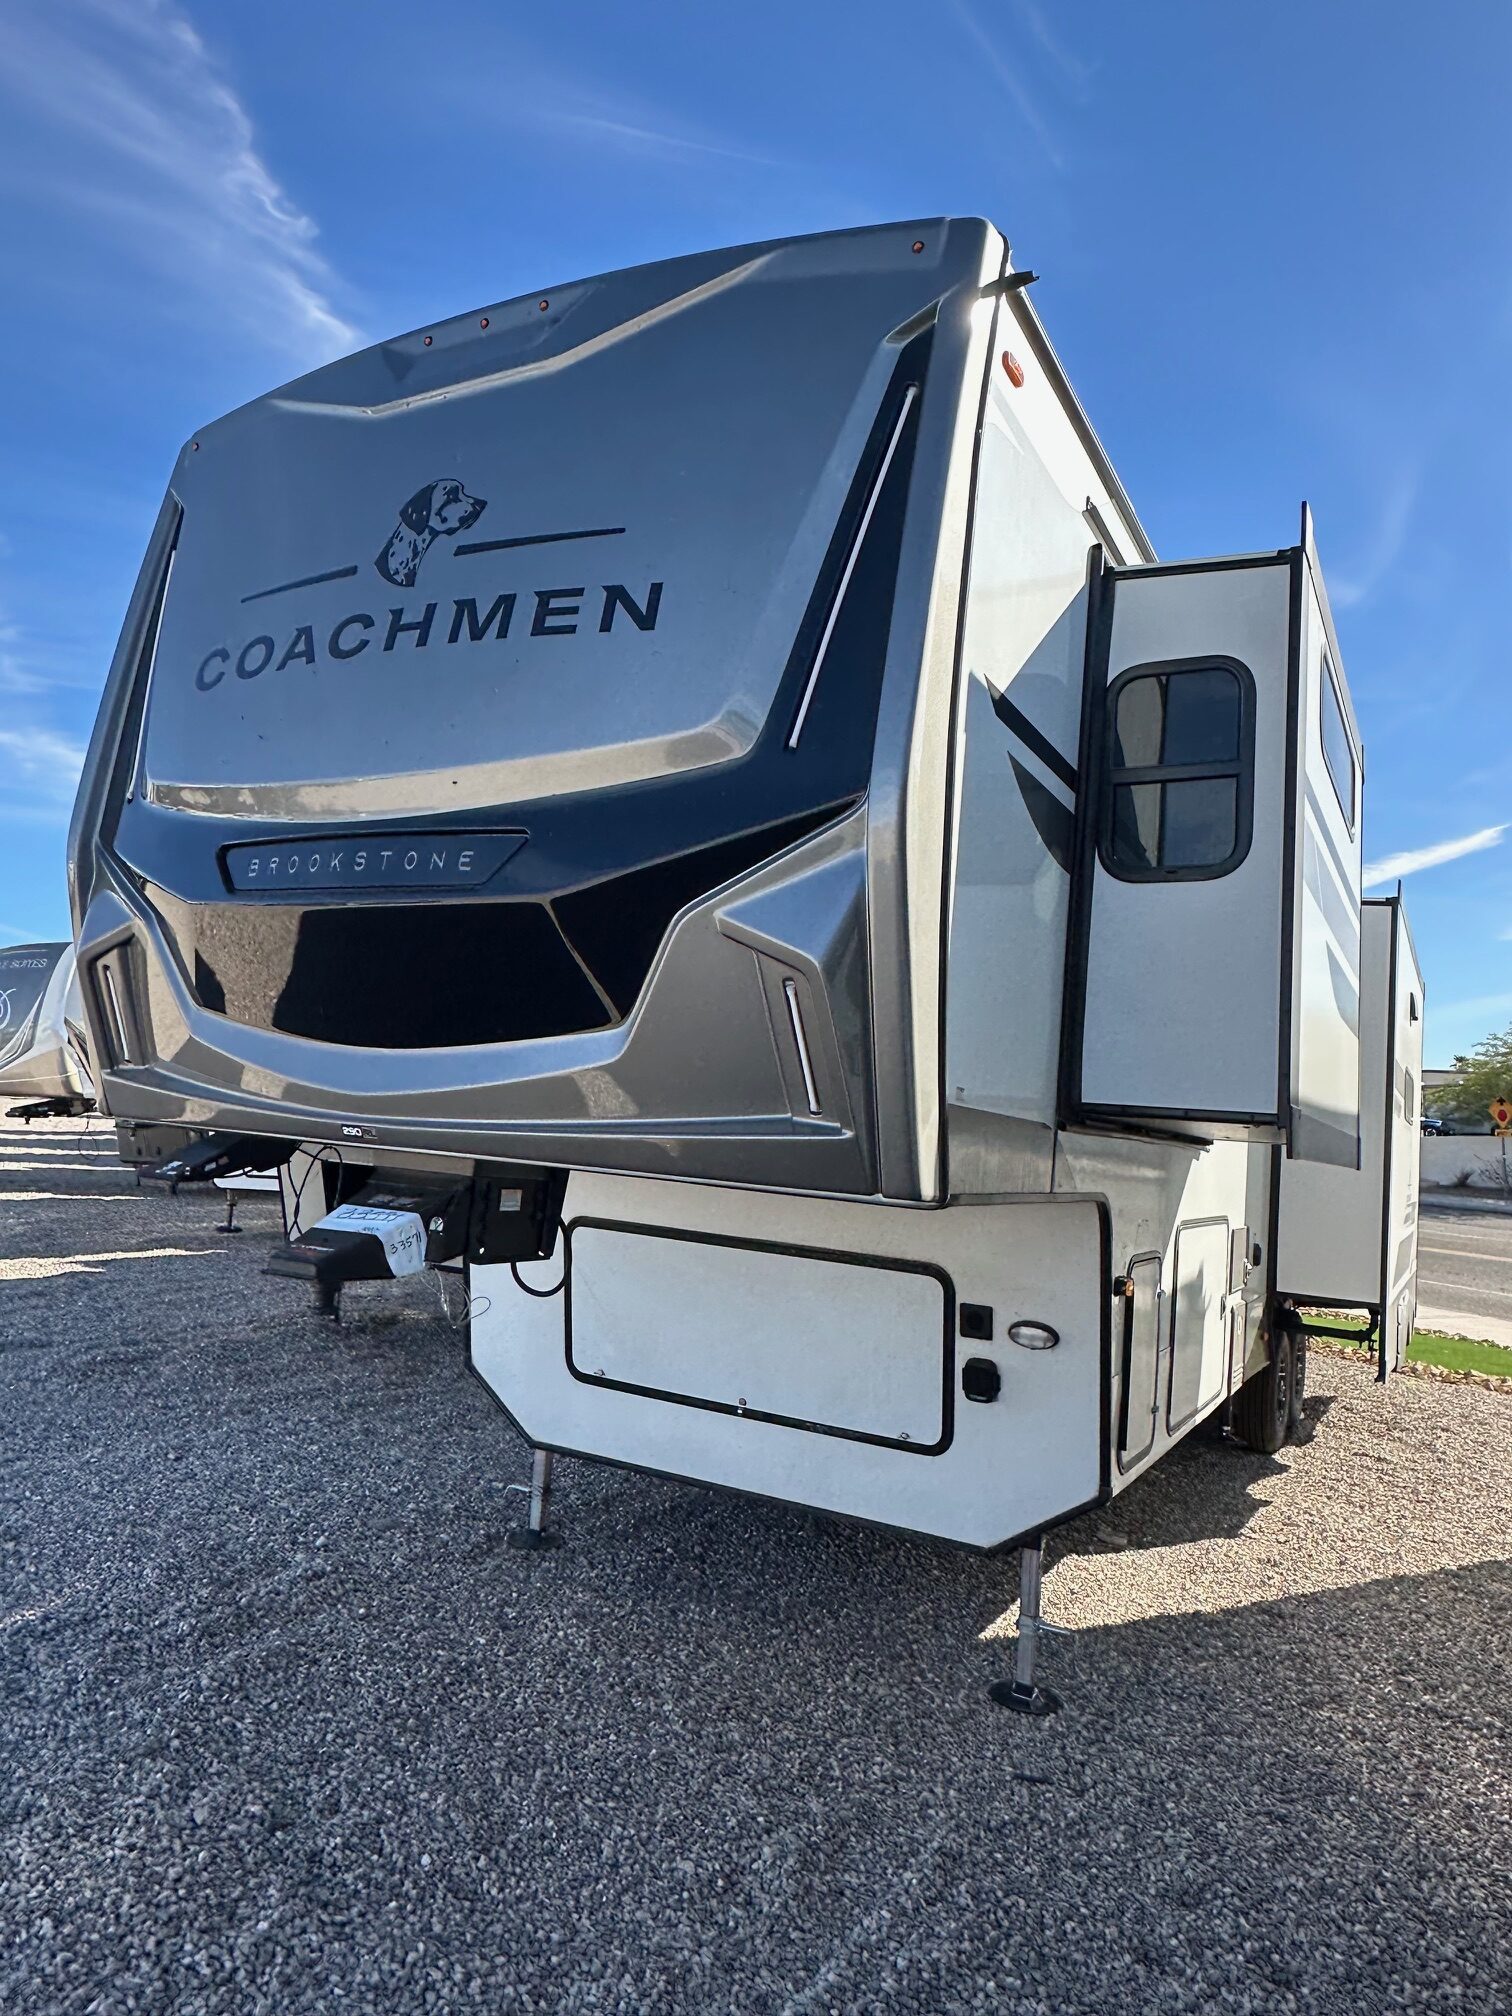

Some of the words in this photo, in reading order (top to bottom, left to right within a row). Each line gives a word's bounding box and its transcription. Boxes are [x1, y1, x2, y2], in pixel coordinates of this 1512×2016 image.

[194, 582, 664, 692] COACHMEN
[247, 850, 475, 878] BROOKSTONE
[389, 1231, 423, 1255] 33571
